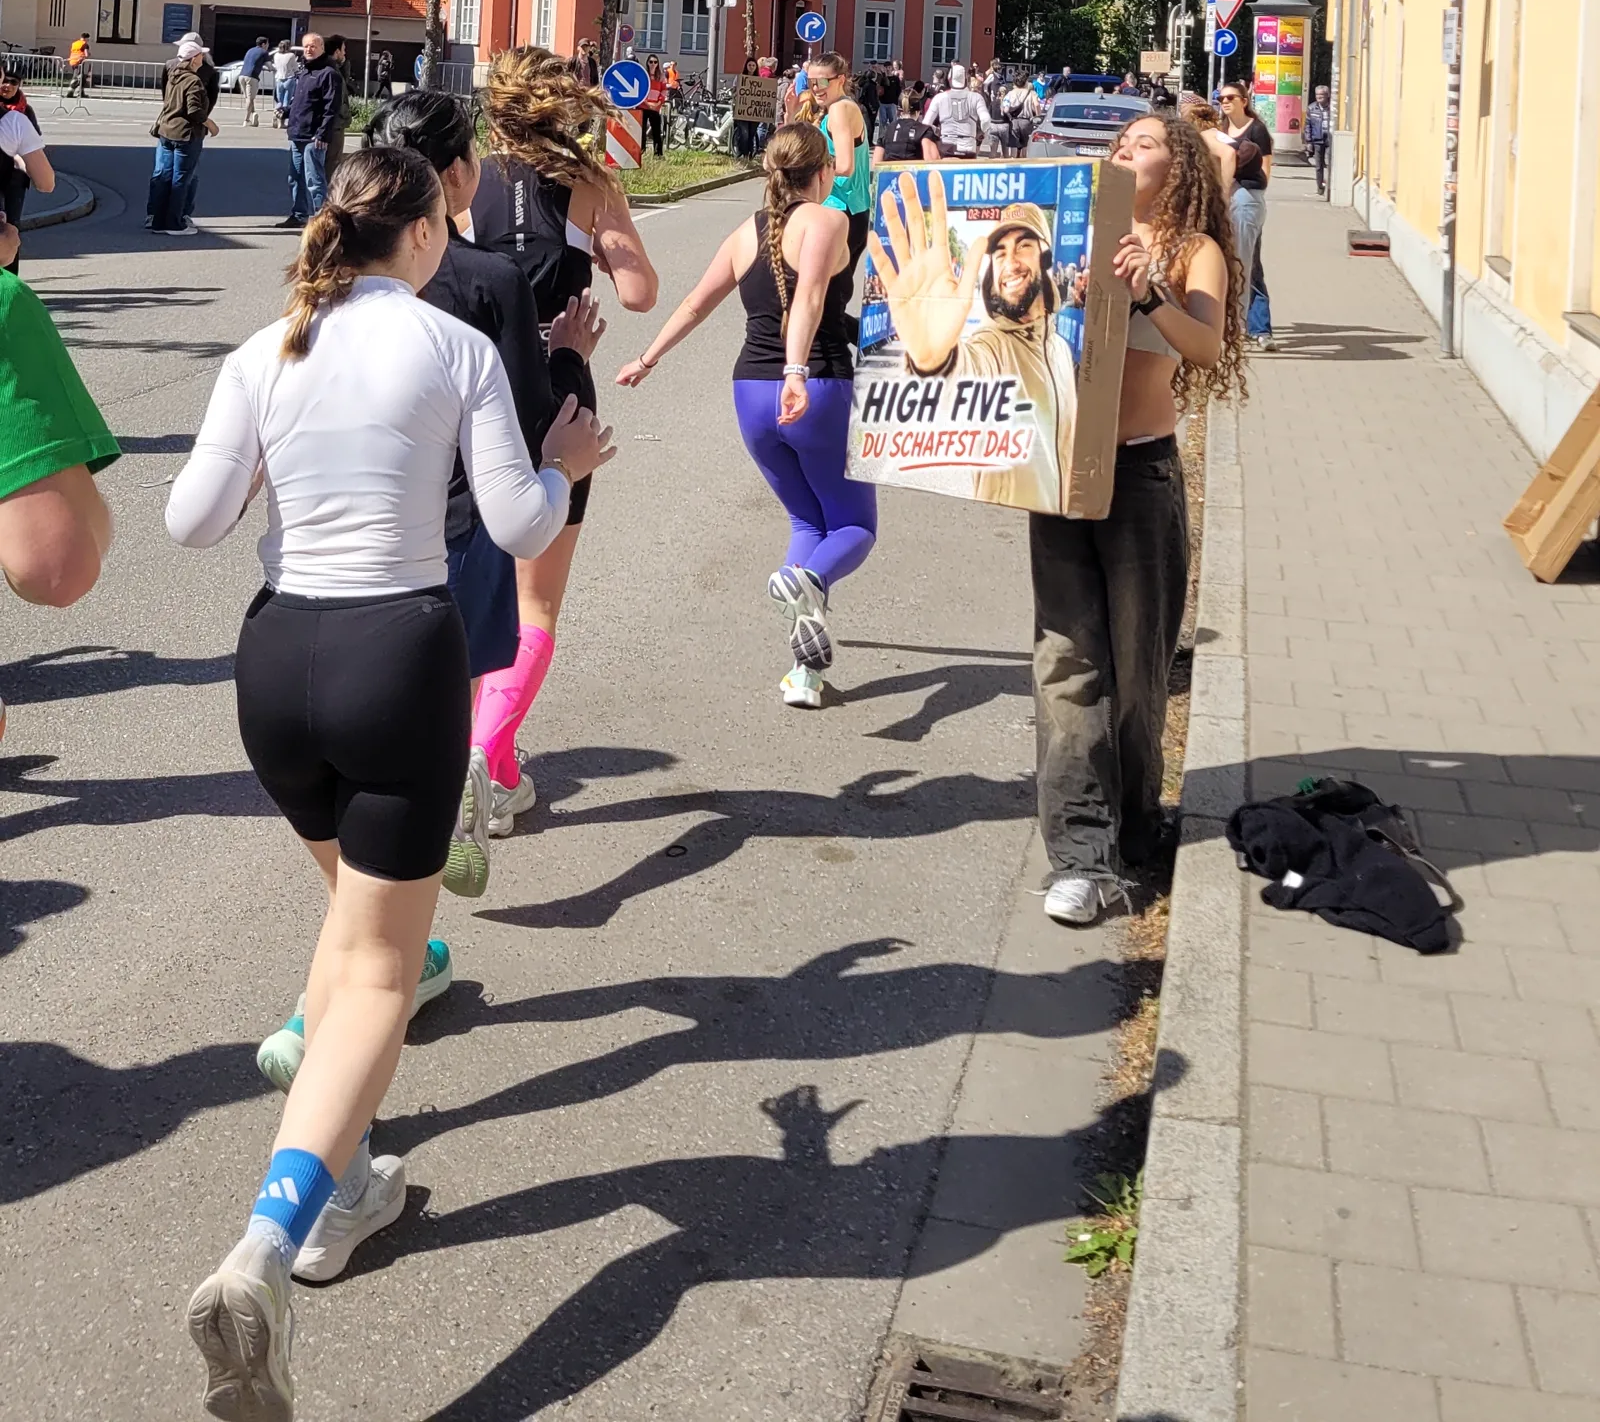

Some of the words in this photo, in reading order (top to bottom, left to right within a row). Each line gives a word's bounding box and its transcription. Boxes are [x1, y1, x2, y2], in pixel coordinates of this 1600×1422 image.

[739, 88, 777, 100] collapse
[741, 76, 748, 87] If
[749, 80, 762, 89] you
[750, 99, 771, 108] pause
[952, 172, 1026, 201] FINISH
[514, 180, 524, 227] KIPRUN
[862, 380, 944, 424] HIGH
[951, 379, 1033, 422] FIVE-
[861, 432, 888, 459] DU
[889, 429, 981, 458] SCHAFFST
[984, 428, 1034, 460] DAS!
